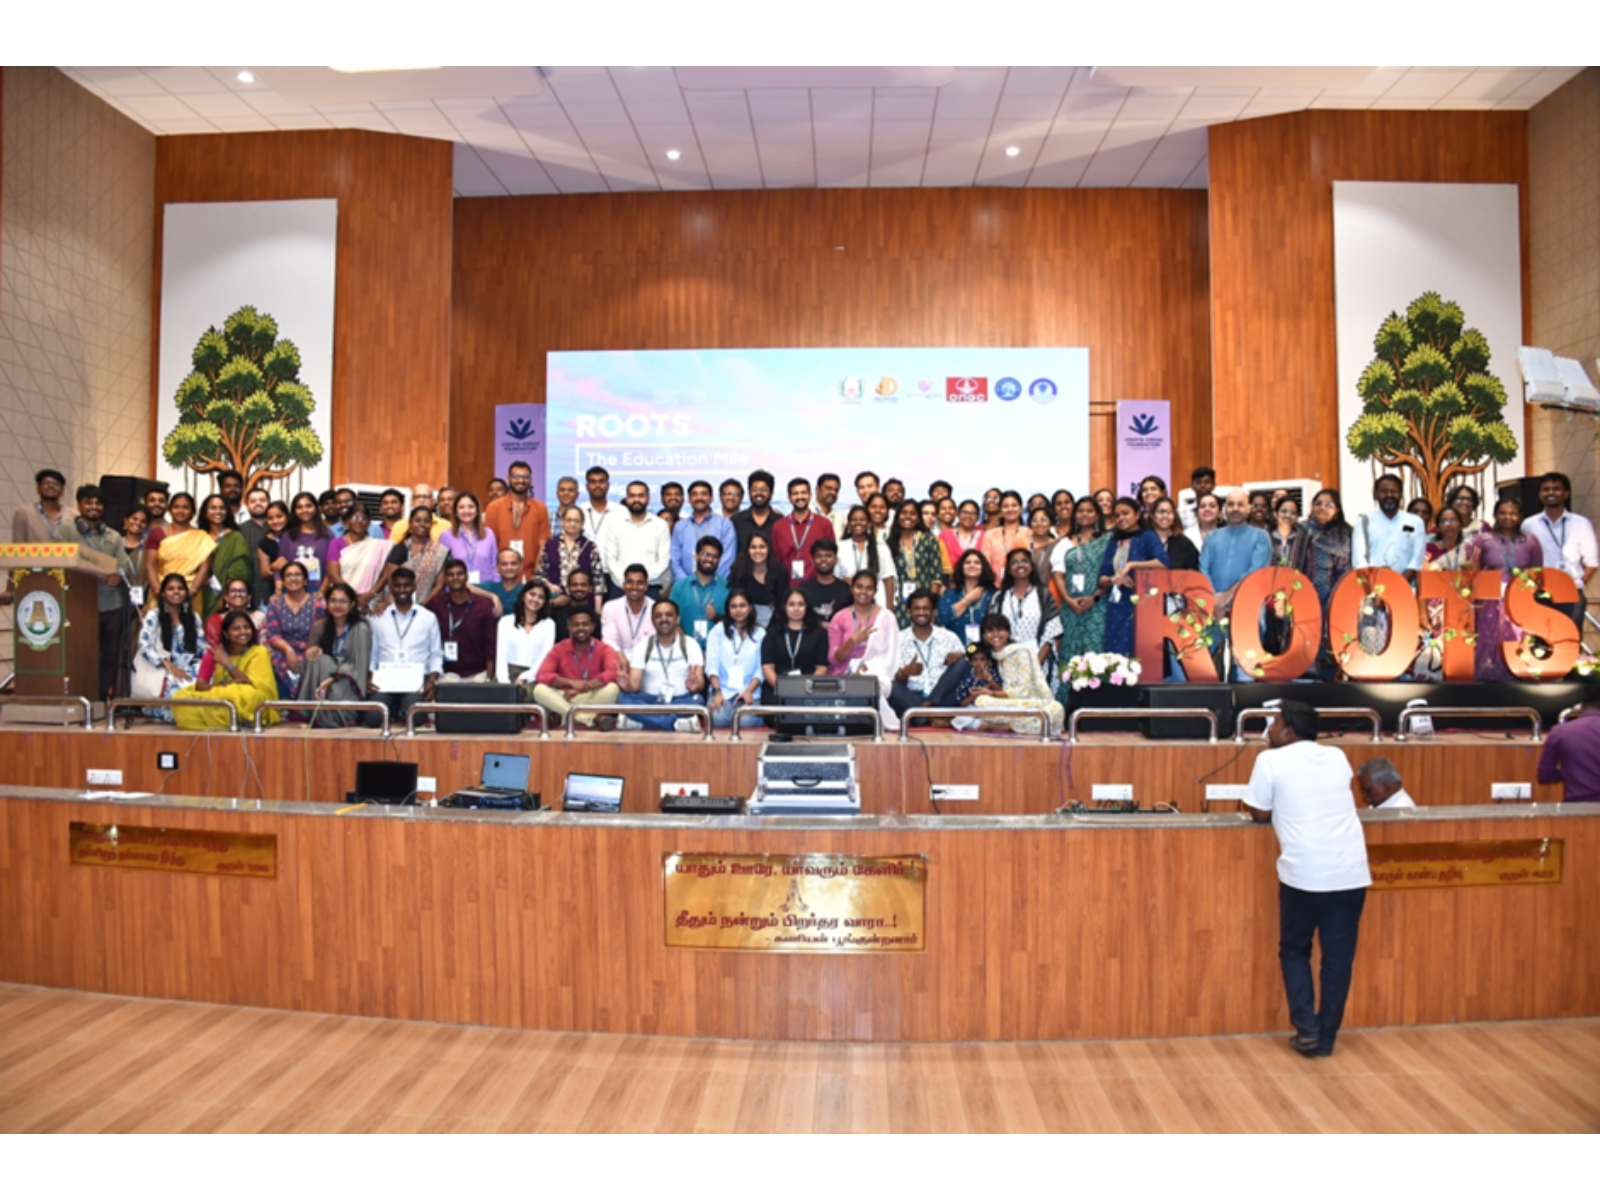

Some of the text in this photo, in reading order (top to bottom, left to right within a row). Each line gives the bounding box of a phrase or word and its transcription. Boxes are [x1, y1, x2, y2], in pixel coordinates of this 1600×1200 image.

[575, 414, 691, 438] ROOTS
[586, 451, 749, 466] The Education Mile
[1135, 566, 1581, 683] ROOTS
[676, 859, 726, 878] யாதும்
[676, 910, 717, 929] தீதும்
[720, 911, 779, 931] நன்றும்
